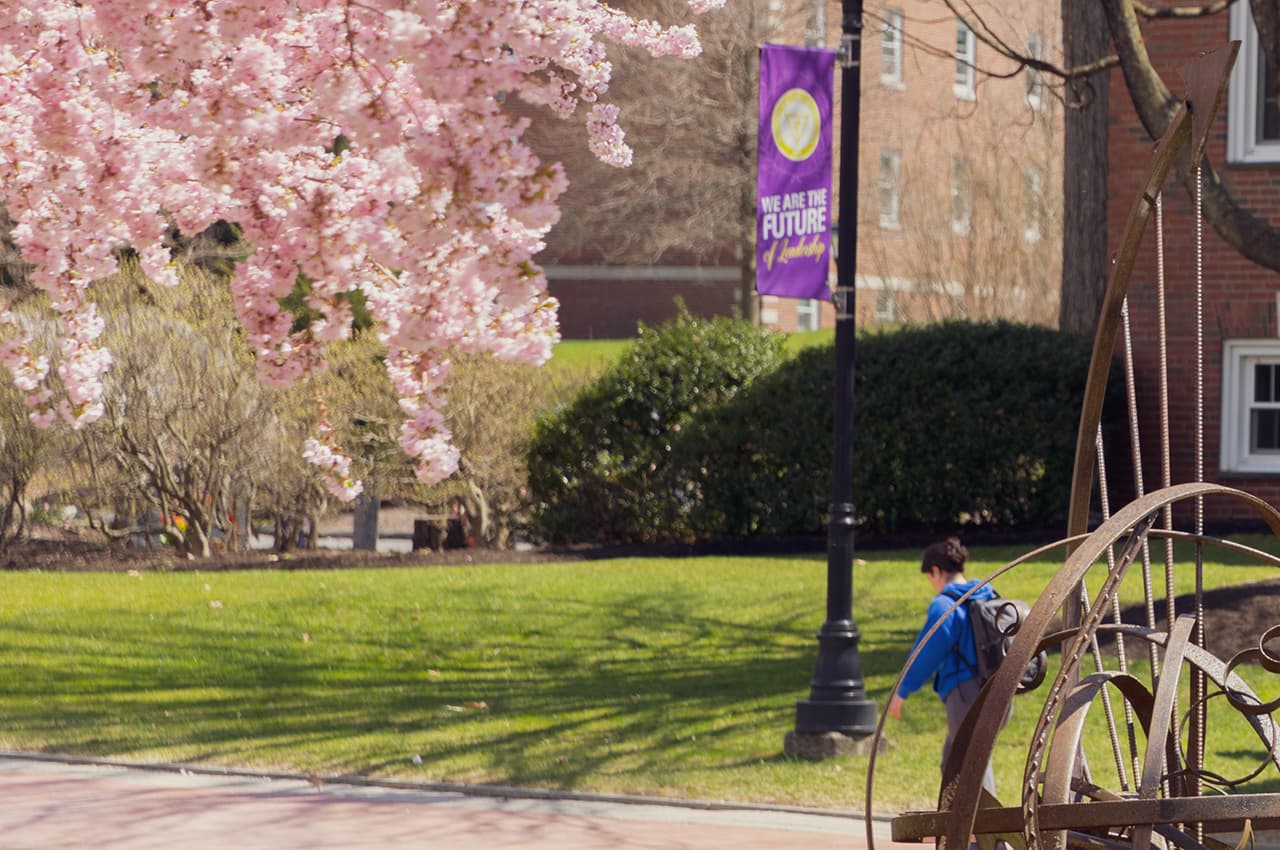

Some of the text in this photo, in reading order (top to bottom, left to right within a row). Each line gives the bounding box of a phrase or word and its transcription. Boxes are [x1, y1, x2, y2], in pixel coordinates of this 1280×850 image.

[762, 189, 826, 213] WE ARE THE
[763, 207, 826, 240] FUTURE
[764, 240, 778, 271] of
